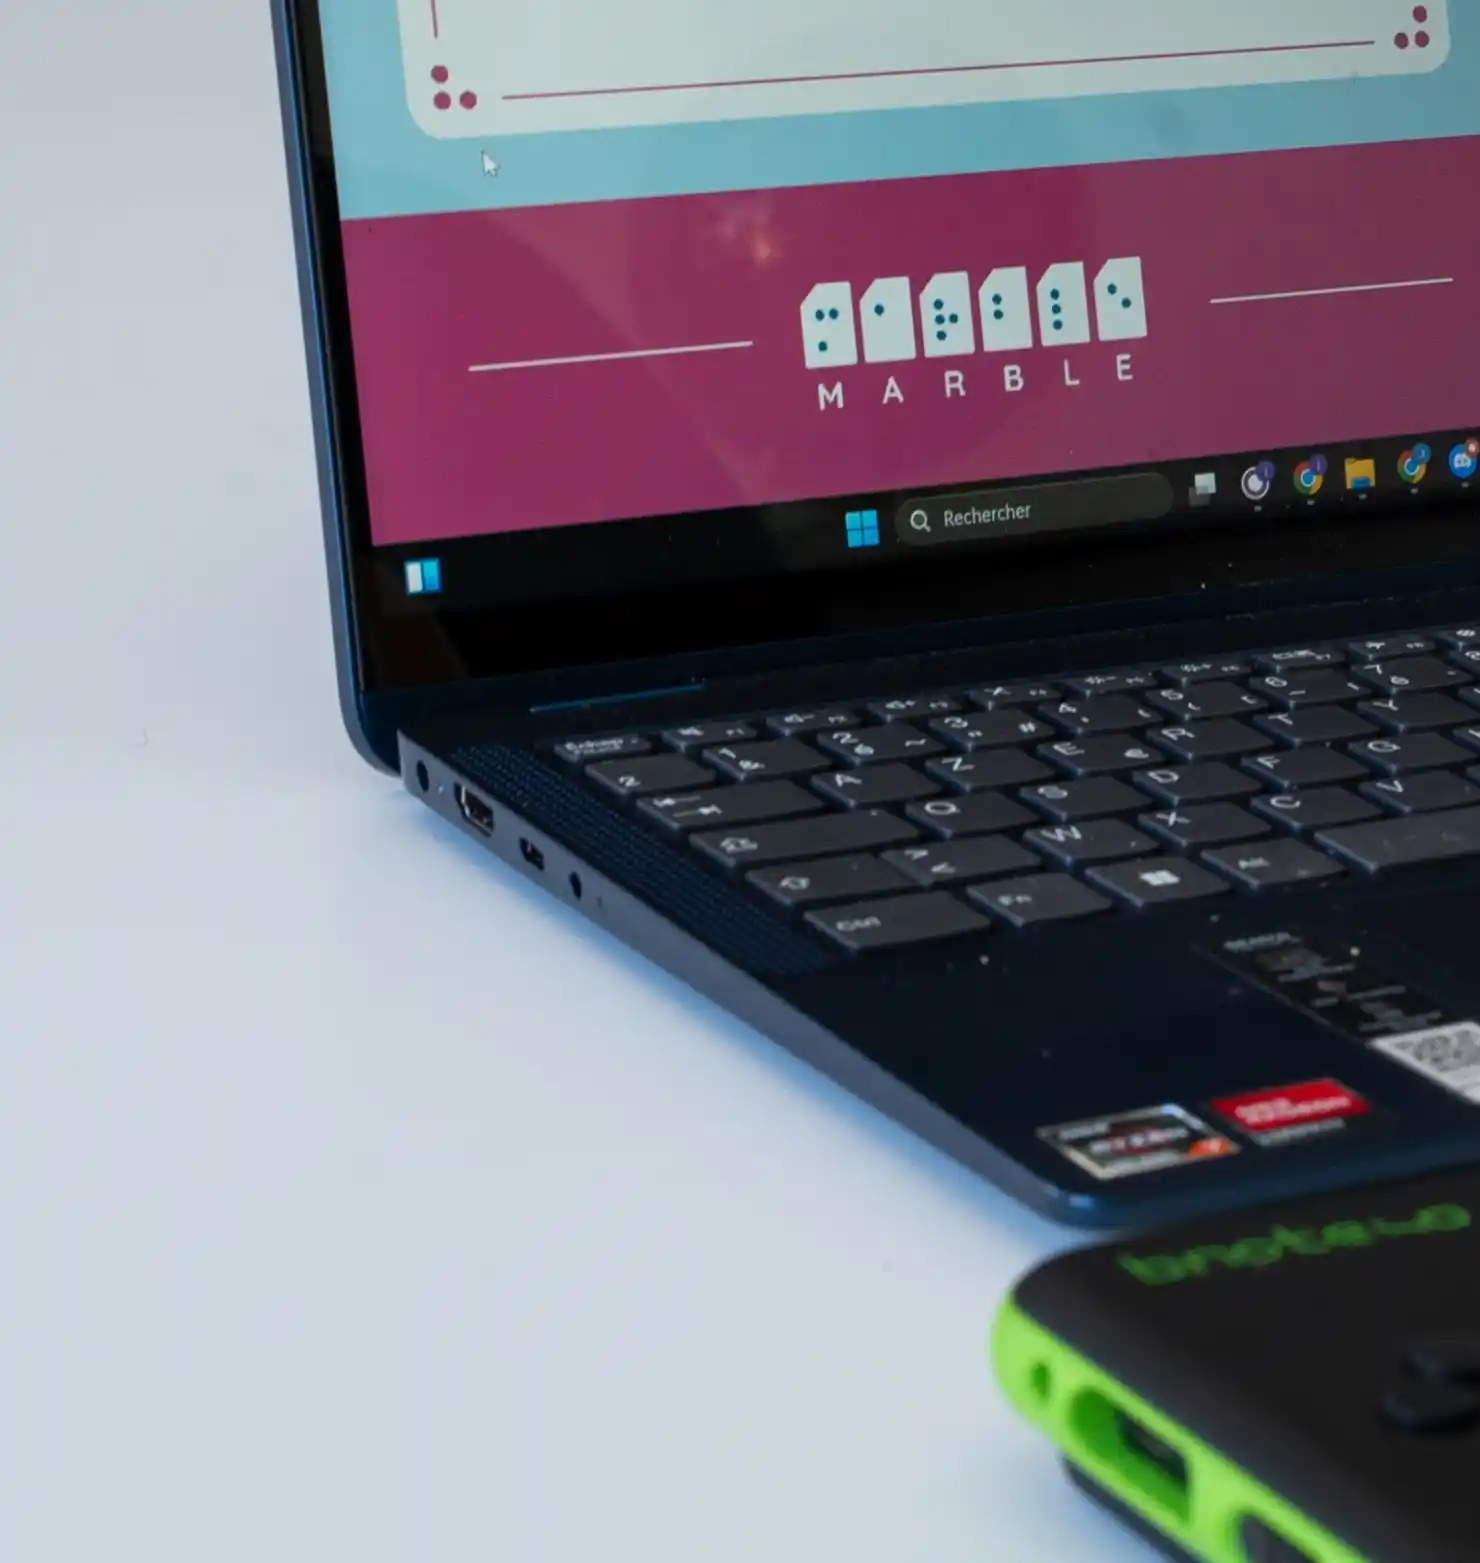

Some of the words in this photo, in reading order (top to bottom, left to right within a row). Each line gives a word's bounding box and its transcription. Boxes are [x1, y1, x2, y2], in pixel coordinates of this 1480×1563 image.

[943, 503, 1032, 528] Rechercher
[1377, 780, 1403, 792] V
[1157, 812, 1189, 825] X
[1041, 826, 1081, 841] W
